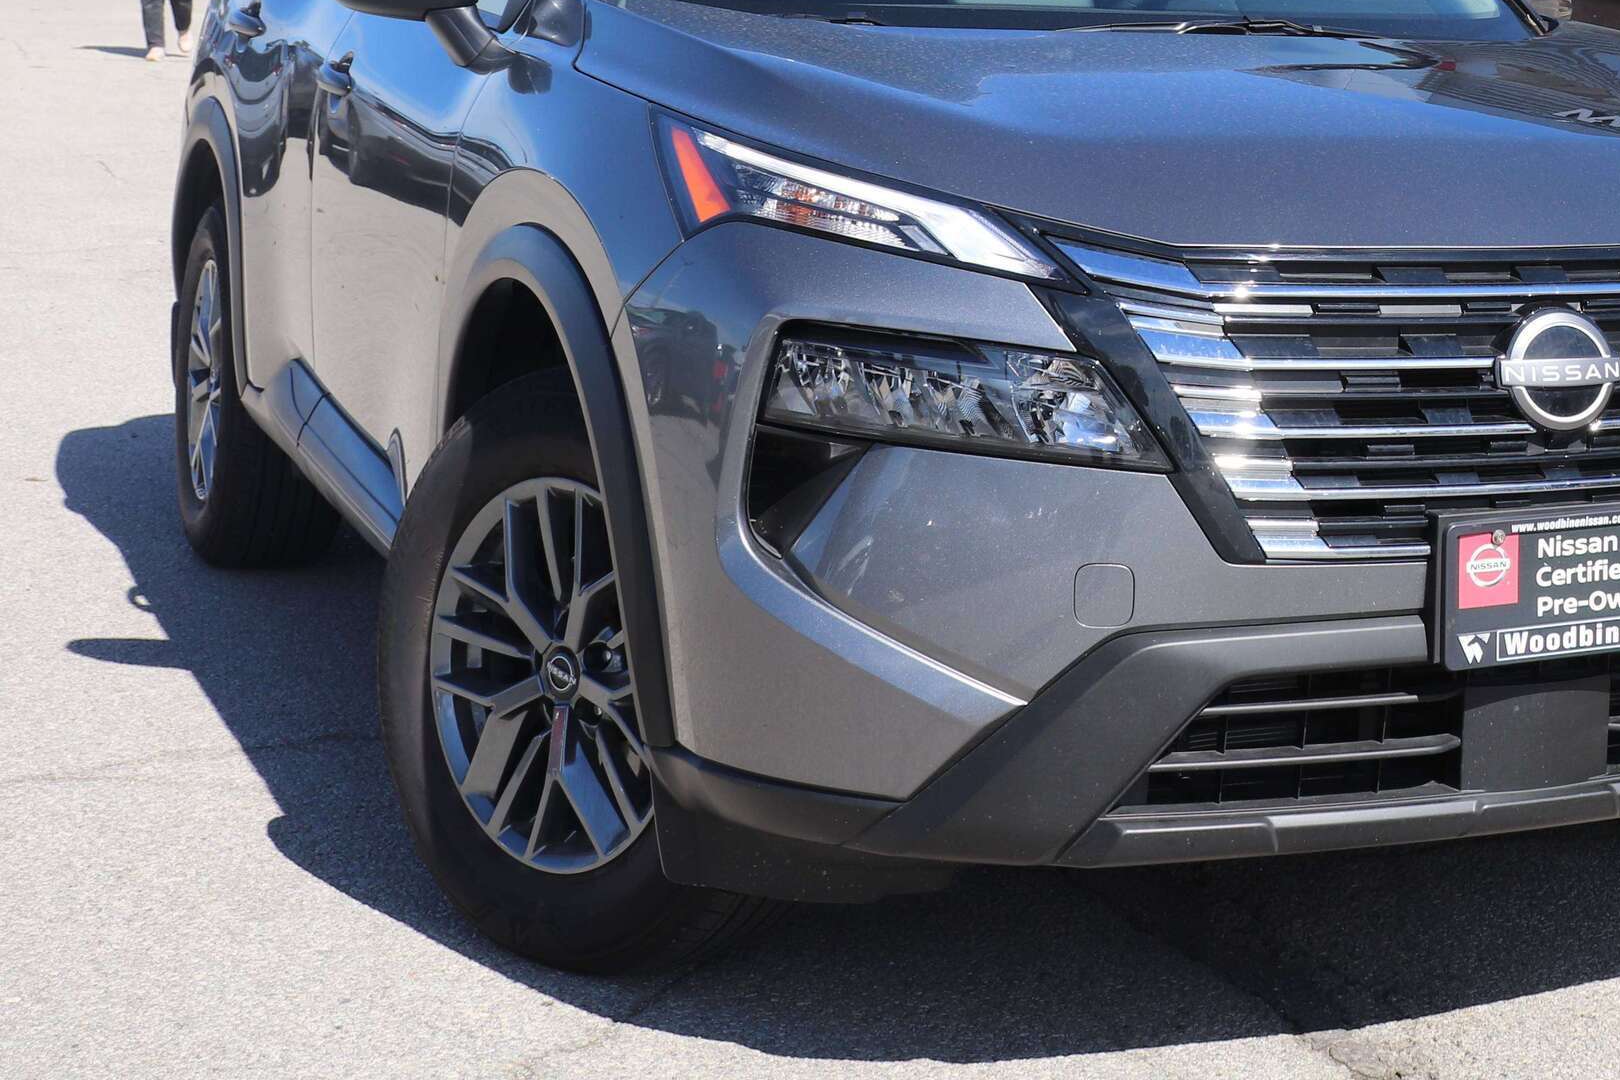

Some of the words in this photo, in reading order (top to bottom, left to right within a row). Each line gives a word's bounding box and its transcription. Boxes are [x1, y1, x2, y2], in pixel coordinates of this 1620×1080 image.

[1504, 361, 1620, 382] NISSAN
[1538, 535, 1618, 559] Nissan
[1470, 560, 1508, 570] NISSAN
